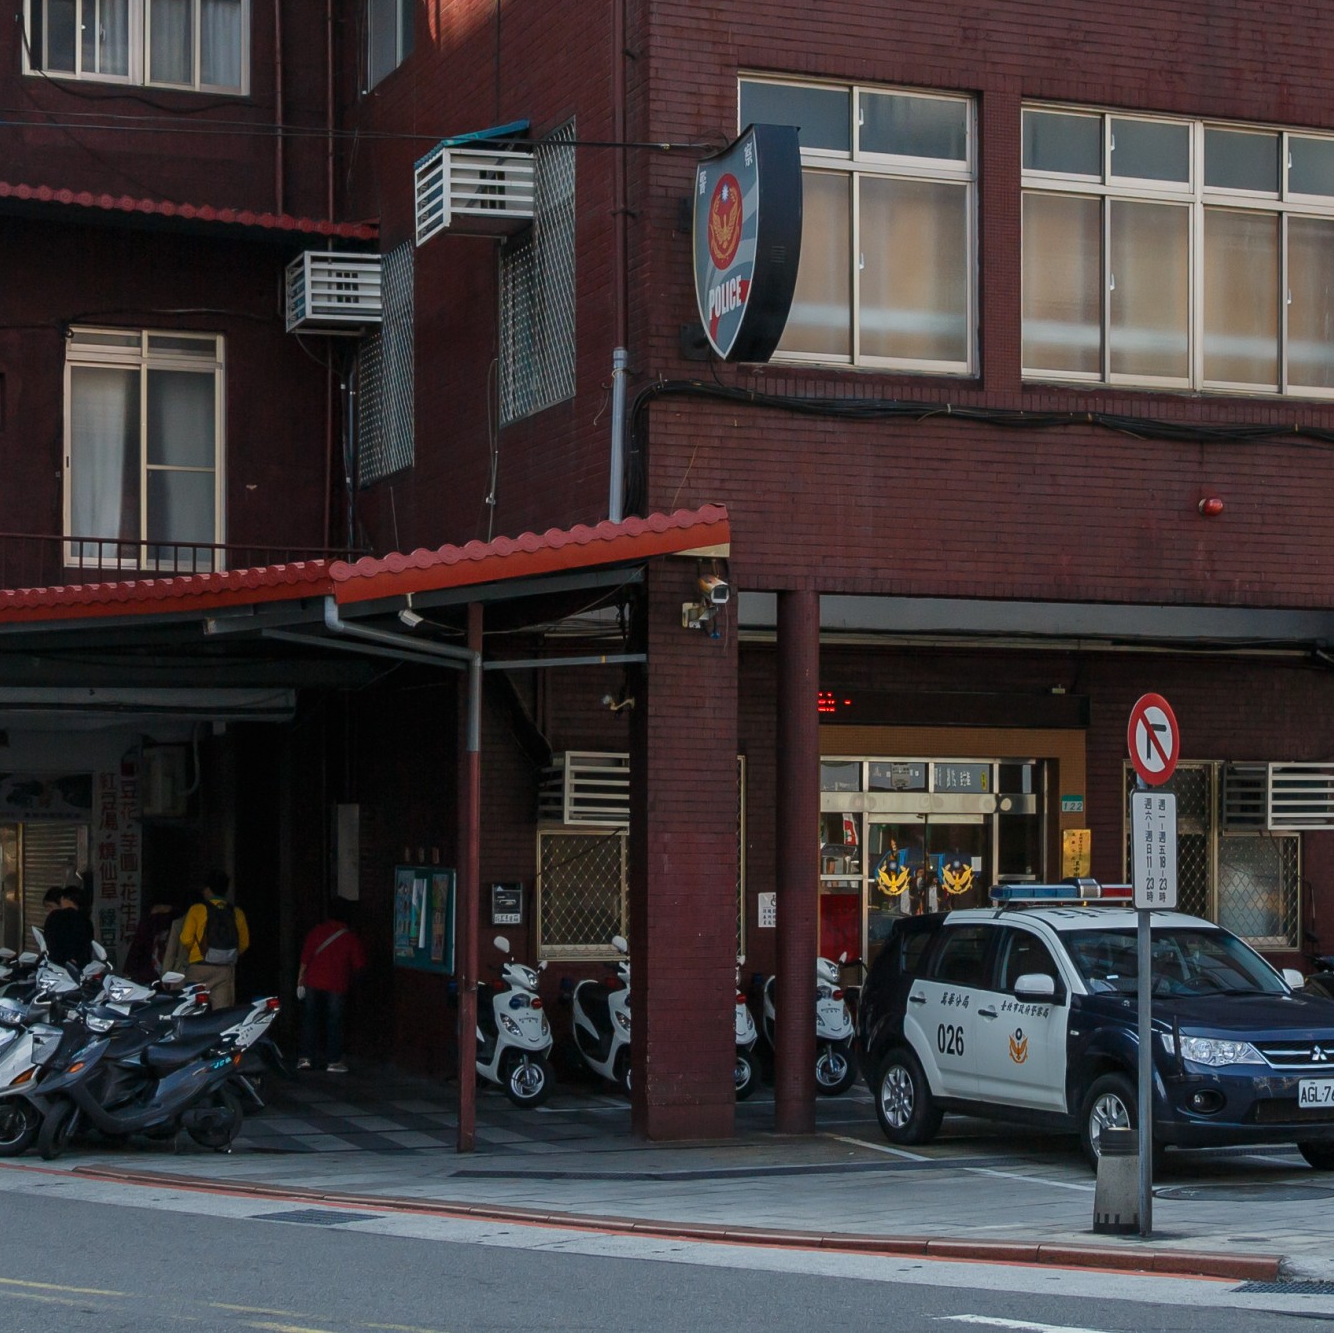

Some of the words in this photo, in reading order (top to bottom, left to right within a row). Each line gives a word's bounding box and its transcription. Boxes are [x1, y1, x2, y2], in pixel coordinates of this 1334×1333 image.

[708, 274, 742, 320] POLICE
[1063, 802, 1083, 811] 122
[937, 1023, 964, 1057] 026
